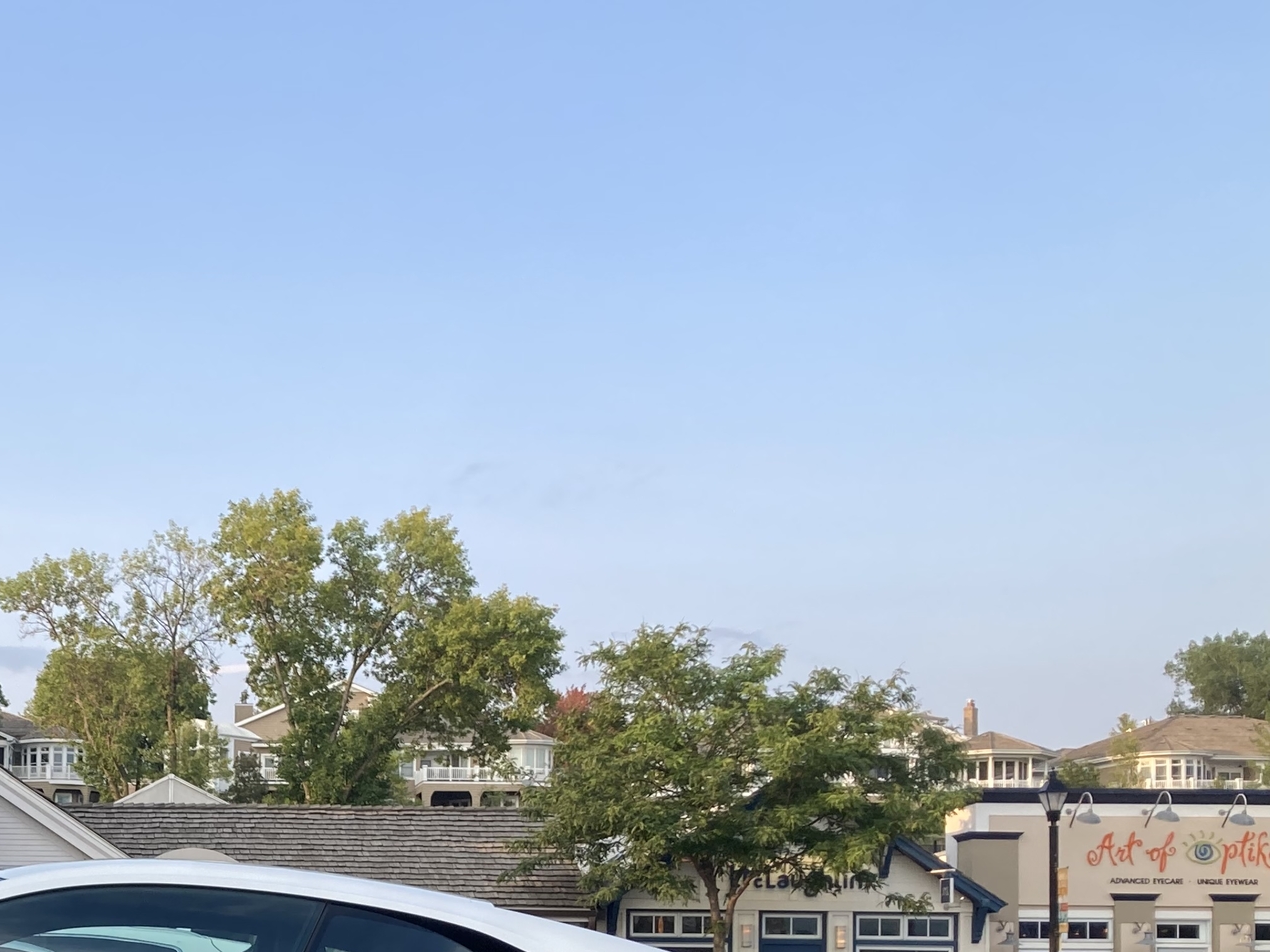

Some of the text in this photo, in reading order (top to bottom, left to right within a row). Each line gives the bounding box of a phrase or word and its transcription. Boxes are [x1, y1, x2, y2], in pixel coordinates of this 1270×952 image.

[1087, 831, 1143, 866] Art
[1146, 831, 1176, 873] of
[1110, 877, 1259, 886] ADVANCED EYECARE UNIQUE EYEWEAR
